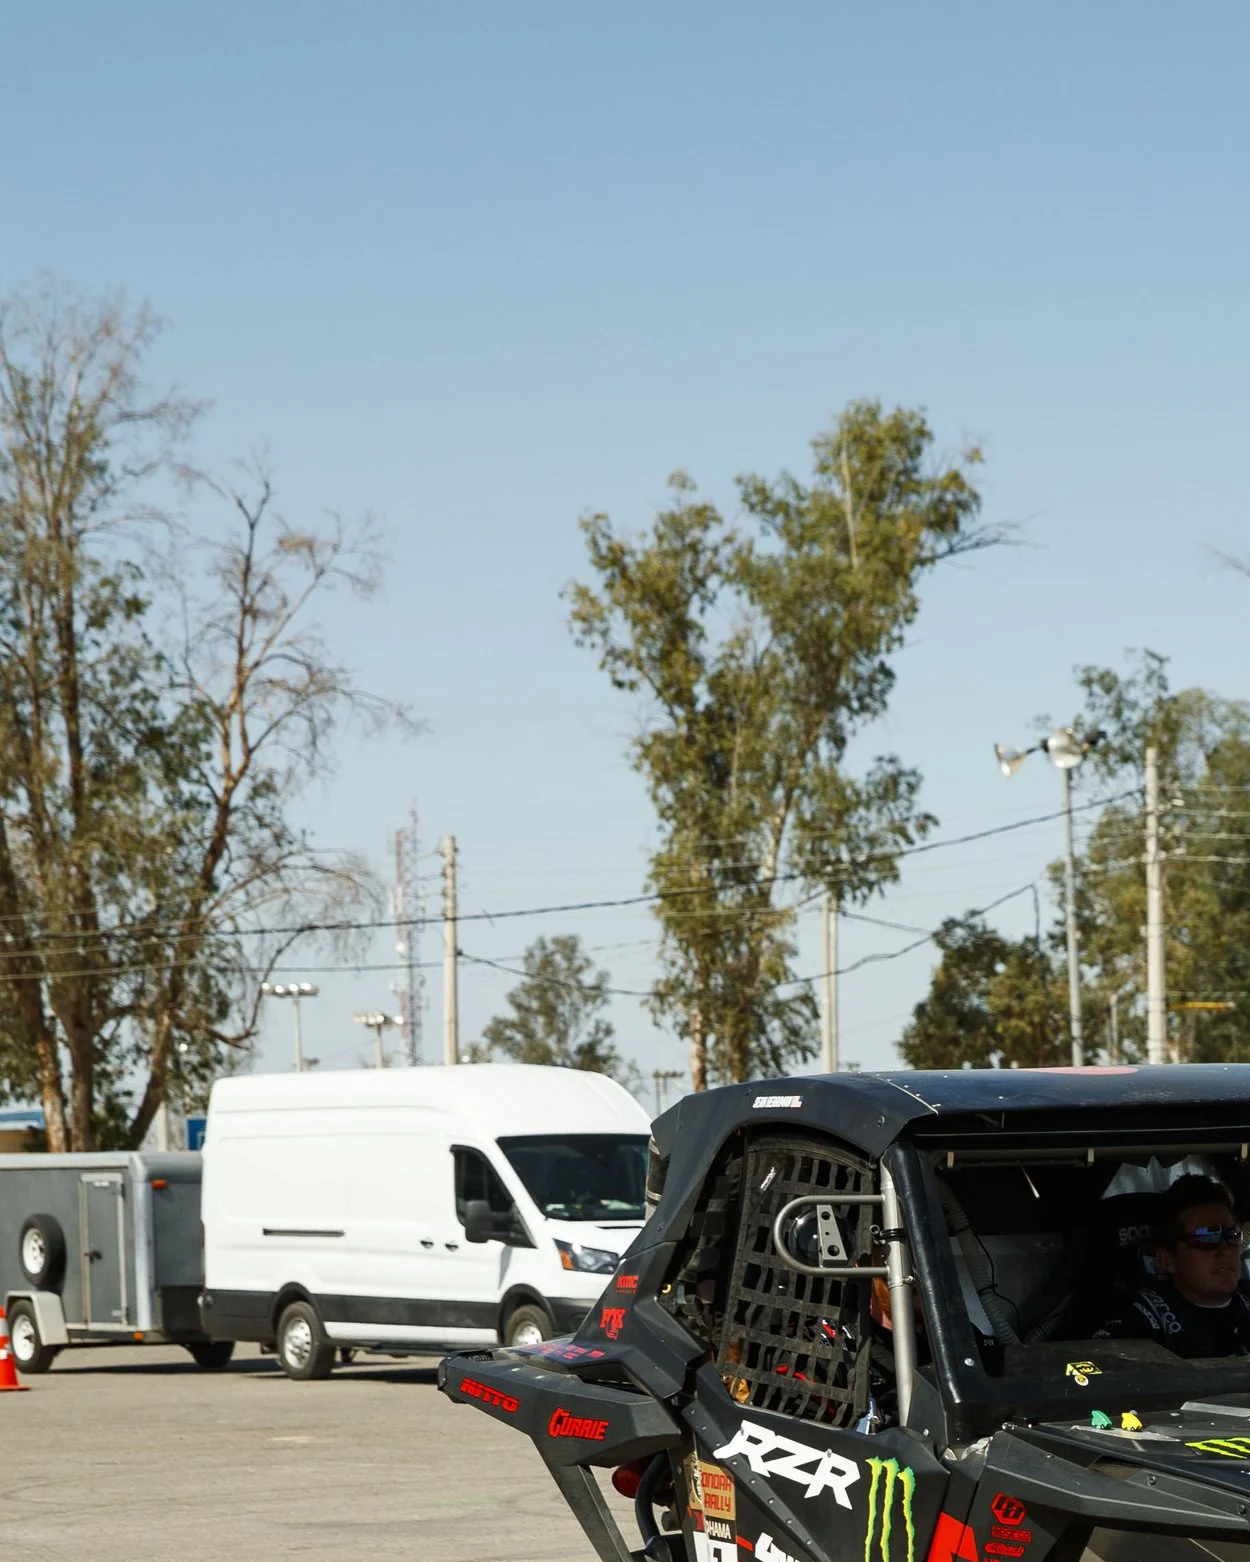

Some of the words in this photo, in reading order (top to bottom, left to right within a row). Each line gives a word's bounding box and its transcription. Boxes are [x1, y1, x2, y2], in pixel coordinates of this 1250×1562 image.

[459, 1376, 521, 1413] NITTO
[701, 1472, 732, 1491] ONORA
[713, 1419, 861, 1510] RZR
